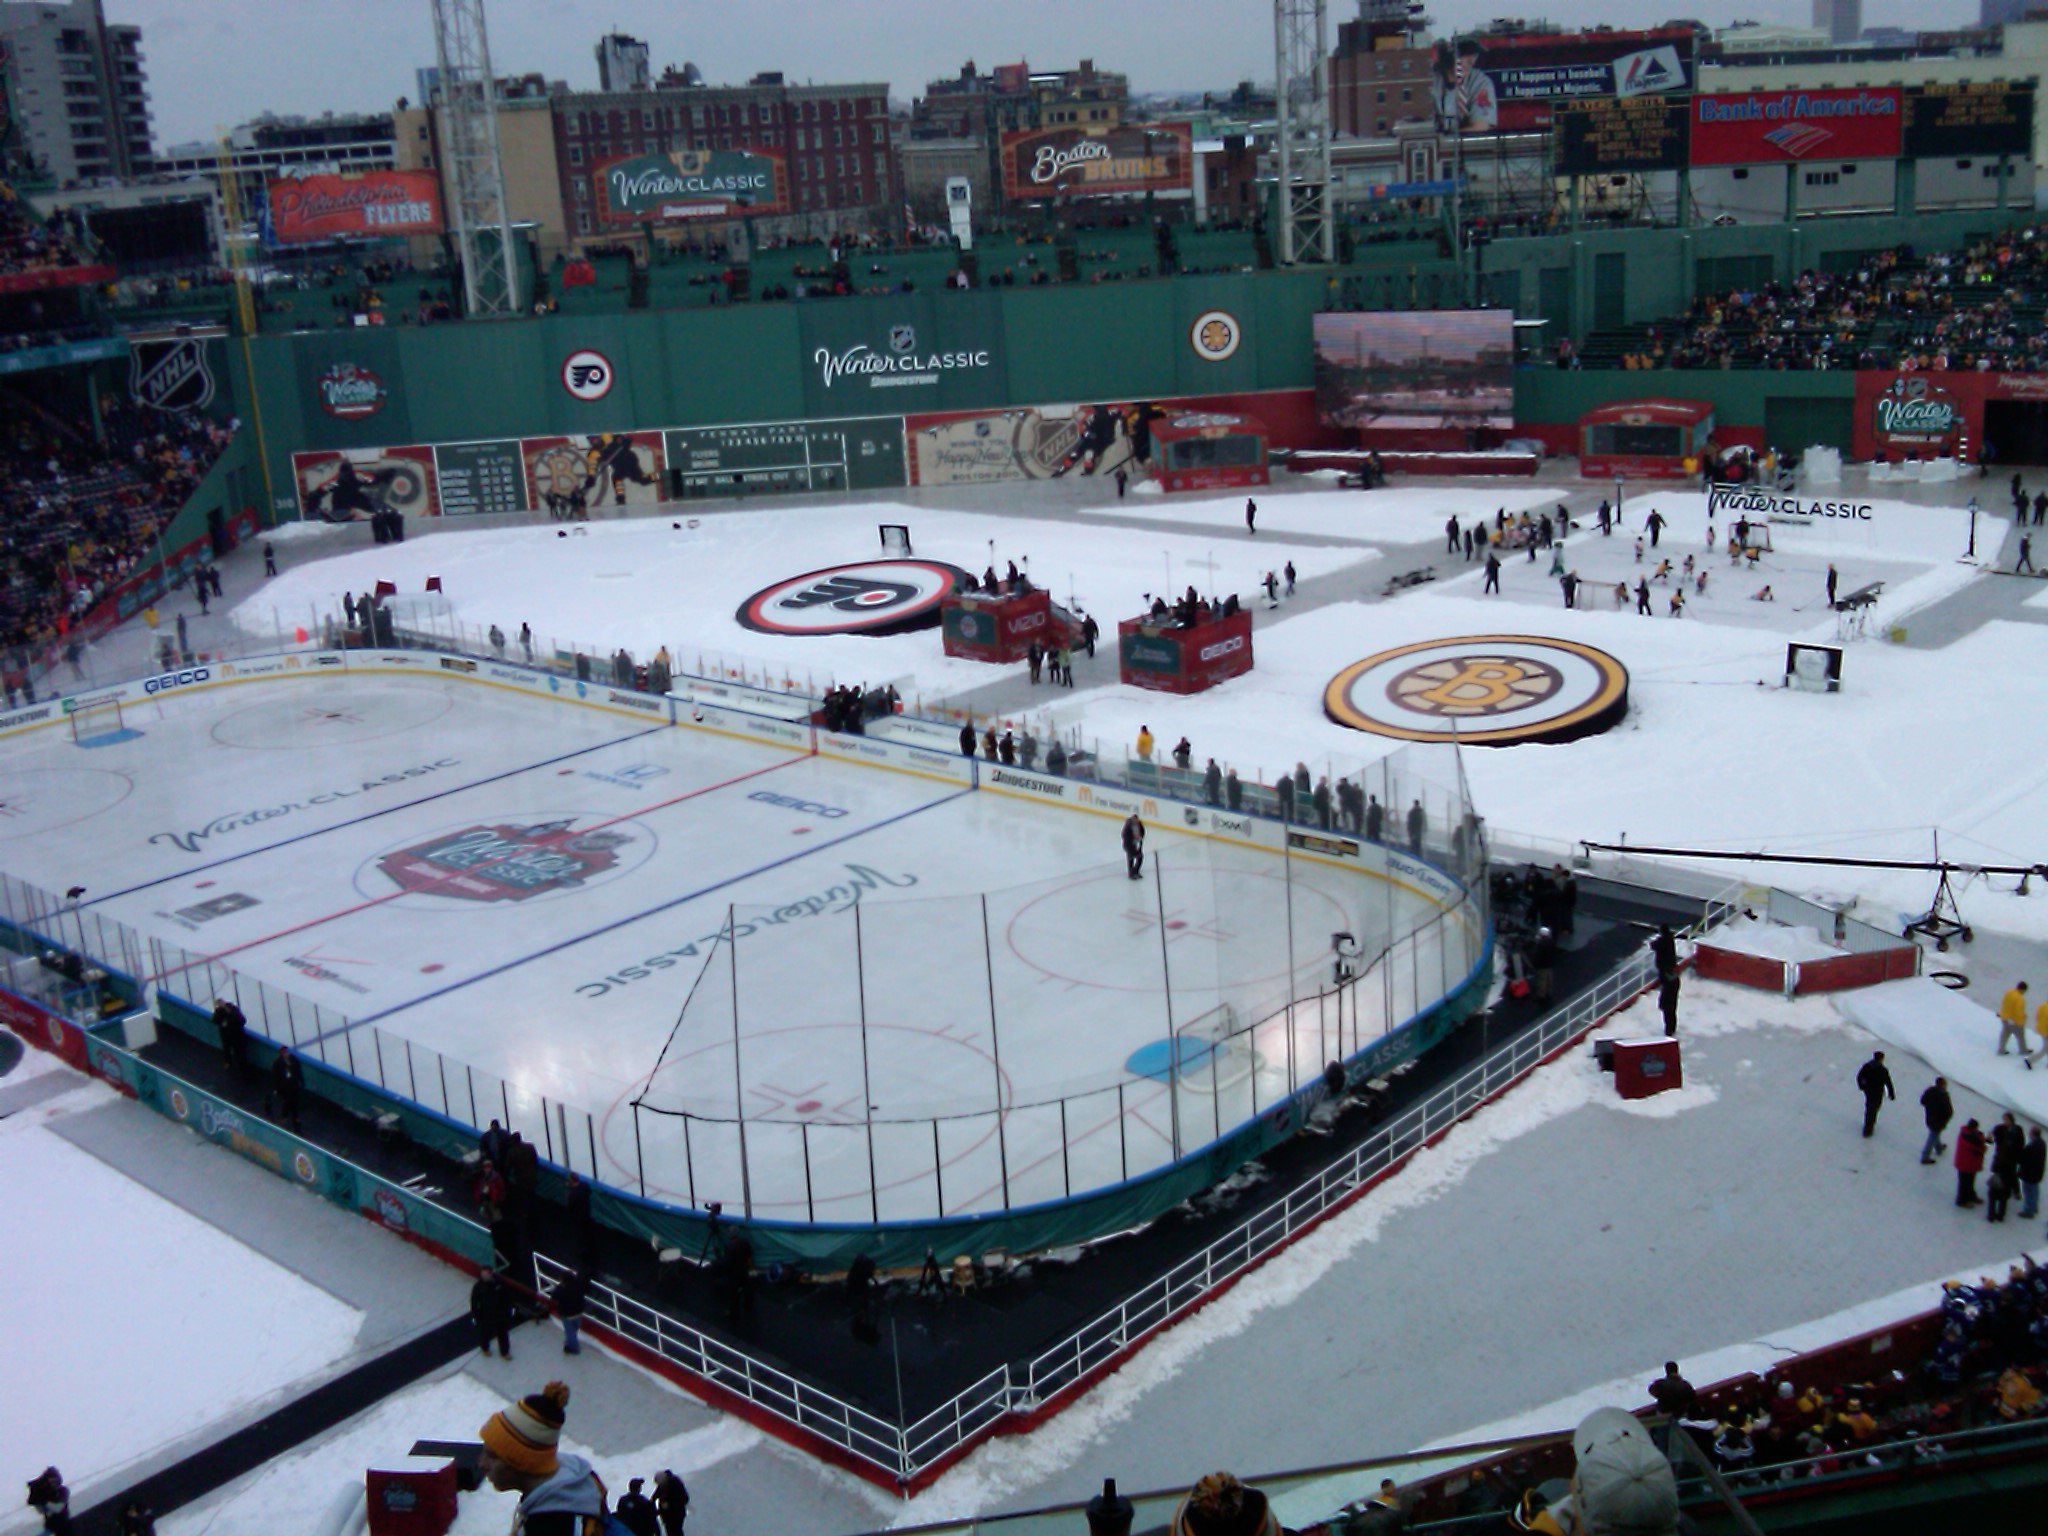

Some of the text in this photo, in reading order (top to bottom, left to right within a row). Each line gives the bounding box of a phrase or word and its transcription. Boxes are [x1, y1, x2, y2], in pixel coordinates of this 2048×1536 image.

[1700, 92, 1896, 121] Bank of America
[1030, 140, 1112, 183] Boston
[1084, 155, 1169, 182] BRUINS
[280, 183, 410, 225] Philadelphia
[613, 168, 767, 207] Winter CLASSIC
[364, 201, 433, 225] FLYERS
[149, 349, 195, 400] NHL
[815, 345, 990, 388] Winter CLASSIC
[1878, 398, 1951, 431] Winter
[1893, 419, 1950, 429] CLASSIC
[700, 425, 806, 438] FENWAY PARK
[1043, 429, 1076, 462] NHL
[1709, 483, 1873, 521] Winter CLASSIC
[1007, 611, 1047, 635] VIZIO
[1201, 635, 1245, 661] GEICO
[144, 666, 211, 695] GEICO
[991, 767, 1065, 796] BRIDGESTONE
[148, 756, 463, 853] Winter CLASSIC
[747, 790, 850, 819] GEICO
[764, 863, 919, 927] Winter
[574, 923, 759, 998] CLASSIC
[200, 1099, 245, 1136] Boston
